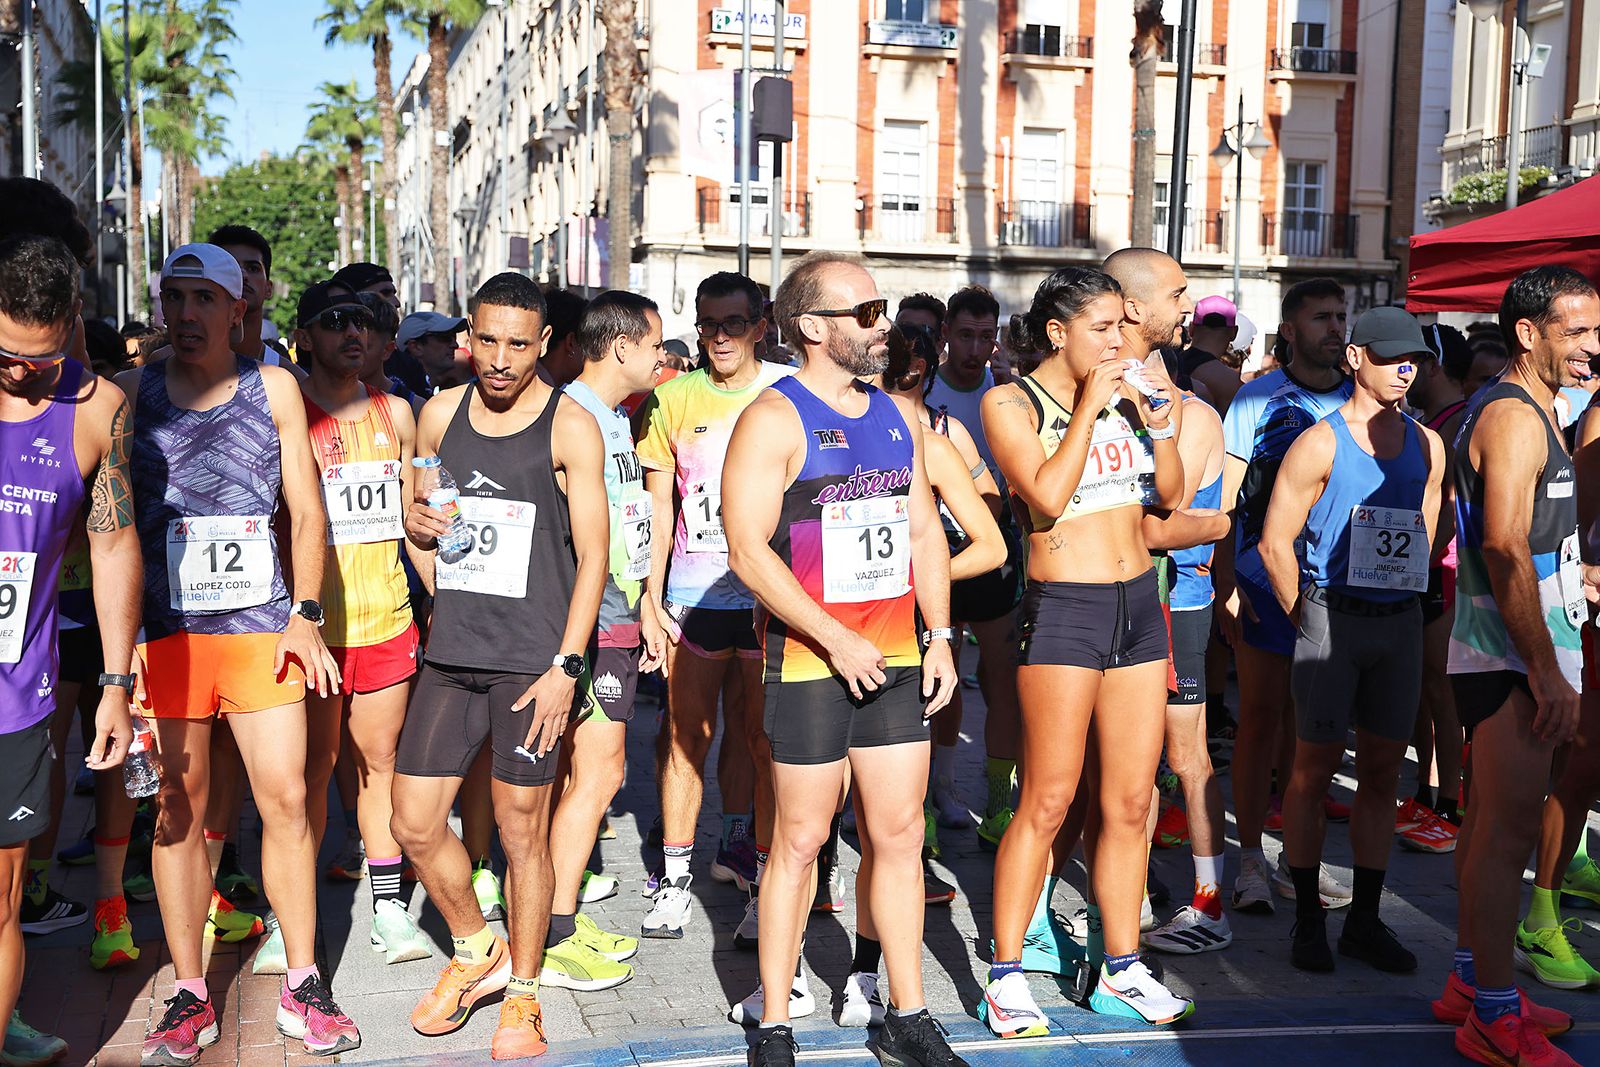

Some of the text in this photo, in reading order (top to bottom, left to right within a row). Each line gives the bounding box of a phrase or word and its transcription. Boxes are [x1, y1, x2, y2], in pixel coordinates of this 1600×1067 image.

[20, 455, 60, 467] HYROX
[1089, 440, 1133, 475] 191
[811, 465, 912, 505] entrena
[2, 484, 58, 503] CENTER
[340, 483, 386, 512] 101
[858, 526, 894, 560] 13
[1376, 530, 1411, 558] 32
[202, 542, 244, 573] 12
[855, 568, 895, 580] VAZQUEZ
[1352, 568, 1388, 581] Huelva
[1376, 563, 1407, 573] JIMENEZ
[190, 580, 251, 591] LOPEZ COTO
[830, 579, 878, 593] Huelva
[175, 589, 221, 602] Huelva
